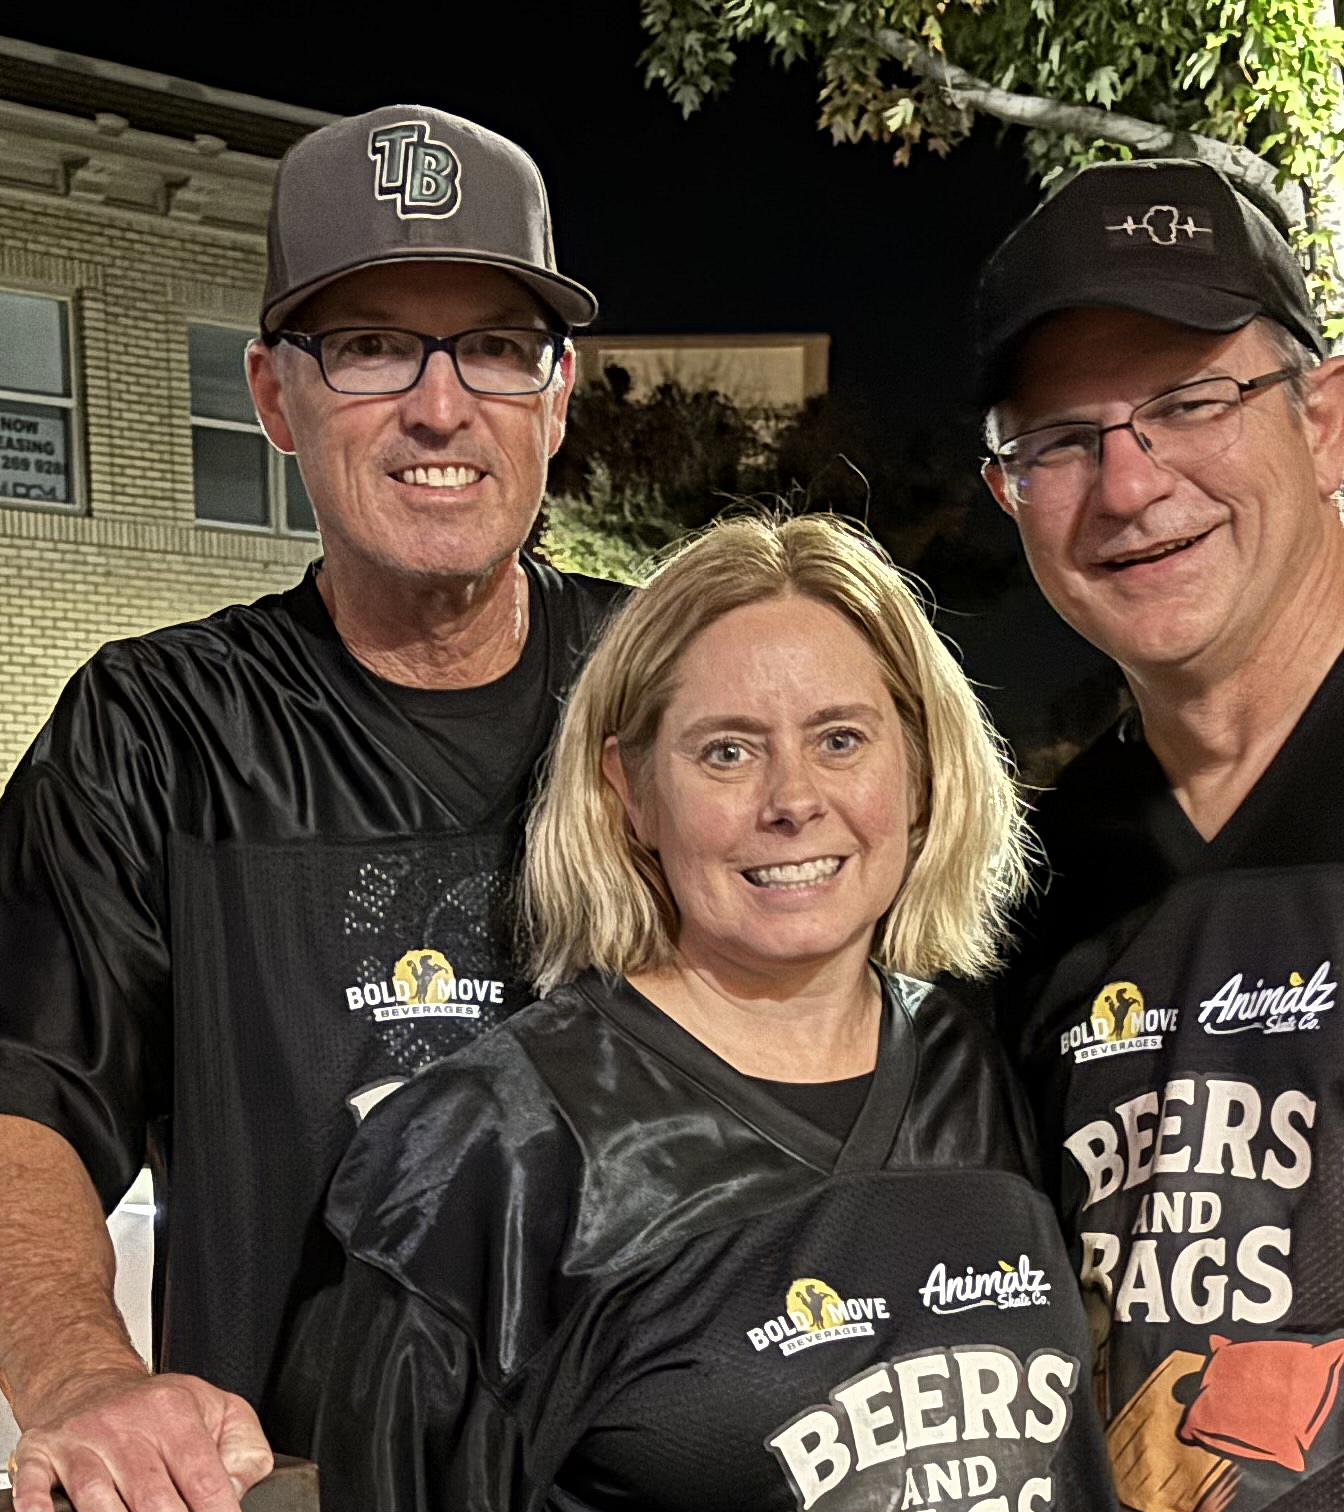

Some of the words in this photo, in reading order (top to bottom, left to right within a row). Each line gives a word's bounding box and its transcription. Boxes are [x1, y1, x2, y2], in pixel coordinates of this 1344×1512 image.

[368, 120, 461, 220] TB
[0, 416, 39, 435] NOW
[346, 980, 410, 1010] BOLD
[436, 978, 504, 1003] MOVE
[381, 1005, 474, 1018] BEVERAGES
[1198, 961, 1337, 1023] Animalz
[1060, 1017, 1110, 1055] BOLD
[1130, 1008, 1179, 1034] MOVE
[1080, 1038, 1158, 1059] BEVERAGES
[1063, 1078, 1316, 1212] BEERS
[1131, 1191, 1222, 1234] AND
[919, 1254, 1051, 1308] Animalz
[1081, 1226, 1293, 1325] BAGS
[747, 1312, 810, 1351] BOLD
[826, 1298, 890, 1323] MOVE
[787, 1325, 868, 1351] BEVERAGES
[770, 1350, 1074, 1511] BEERS
[901, 1456, 997, 1510] AND
